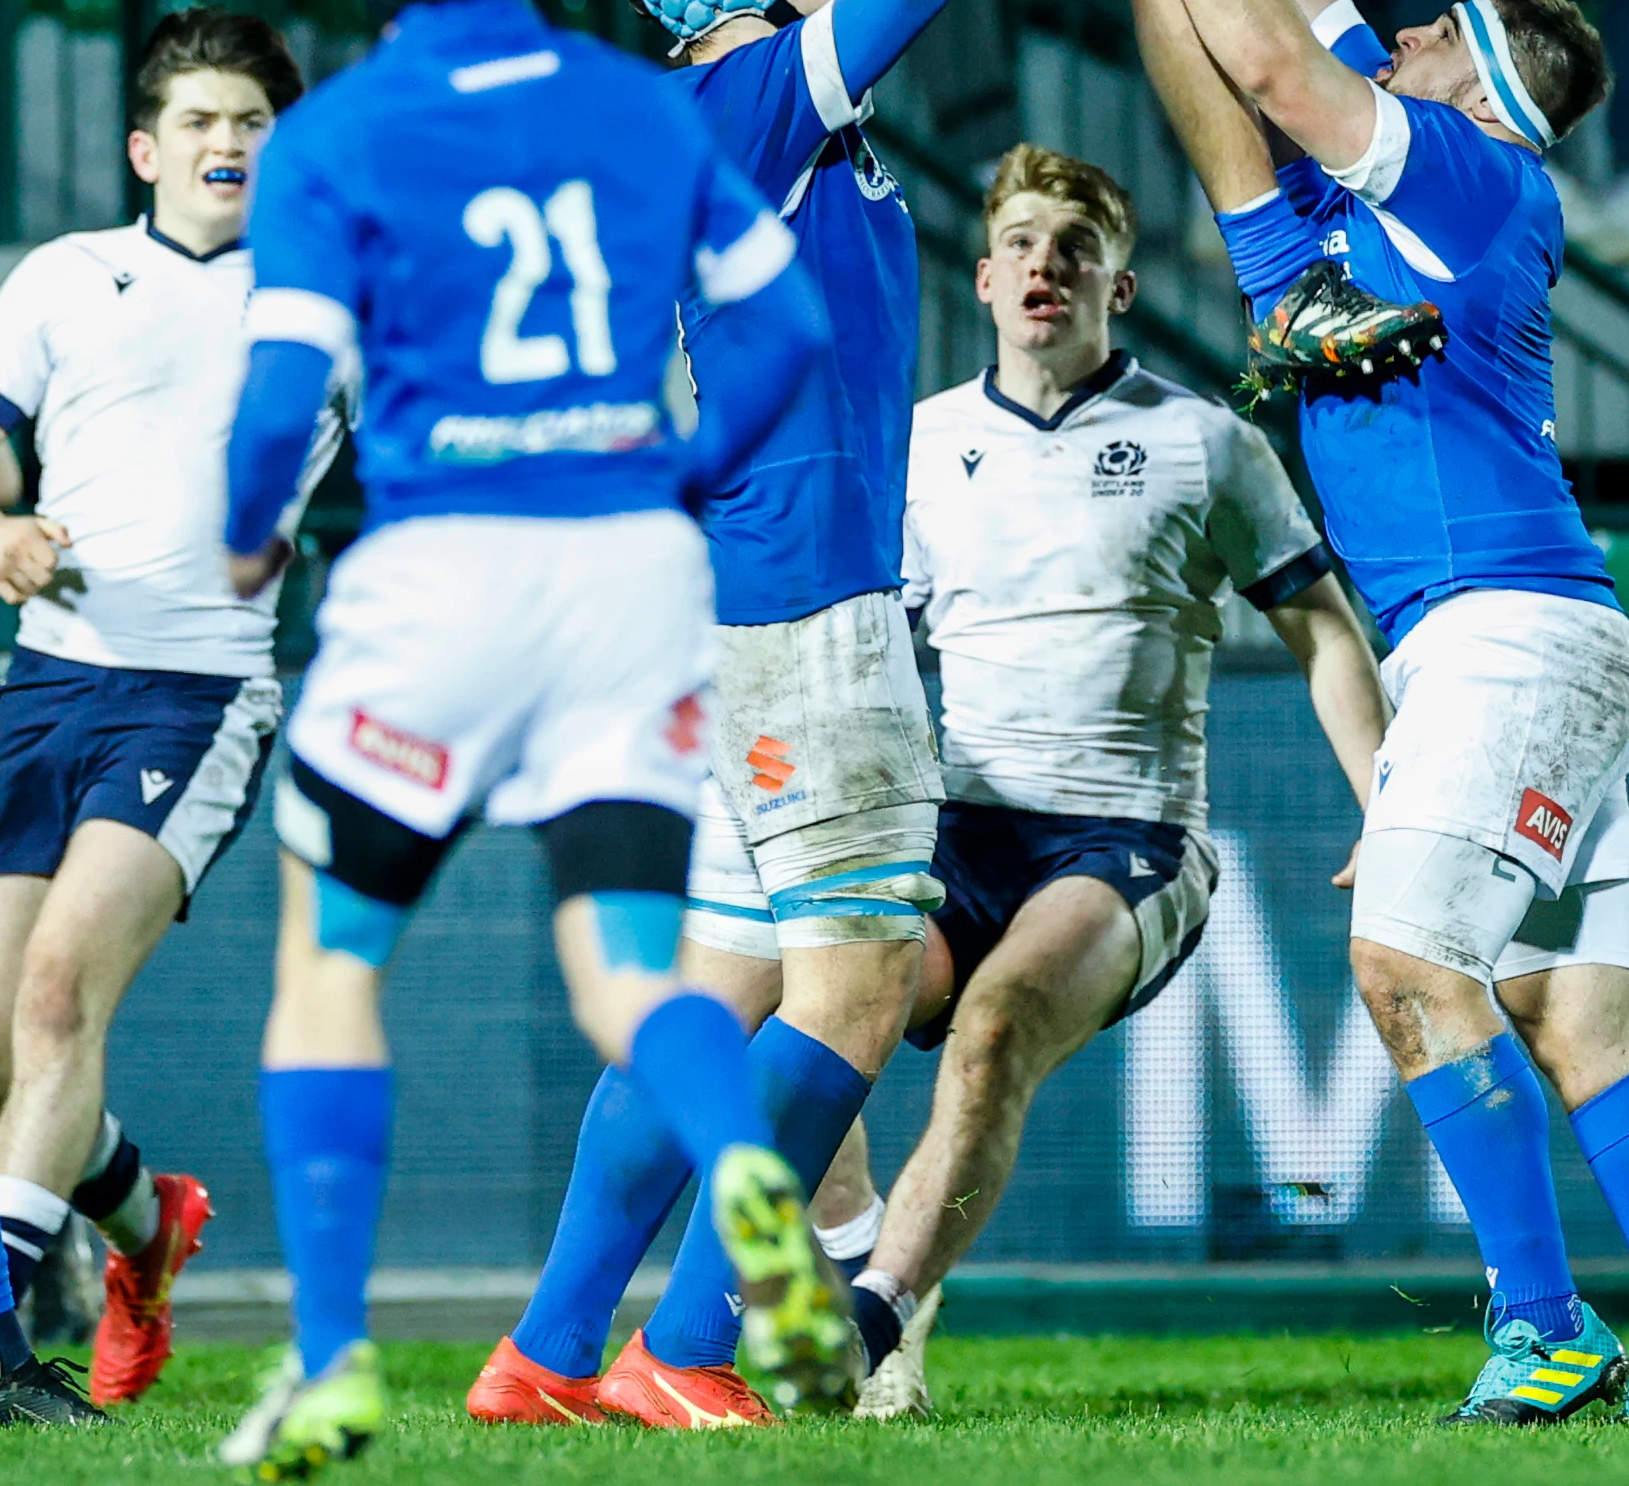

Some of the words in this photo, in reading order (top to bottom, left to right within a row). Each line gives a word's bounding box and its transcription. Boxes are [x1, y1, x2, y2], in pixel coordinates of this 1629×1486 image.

[462, 177, 618, 385] 21
[756, 789, 807, 815] SUZUKI
[1525, 805, 1568, 850] AVIS
